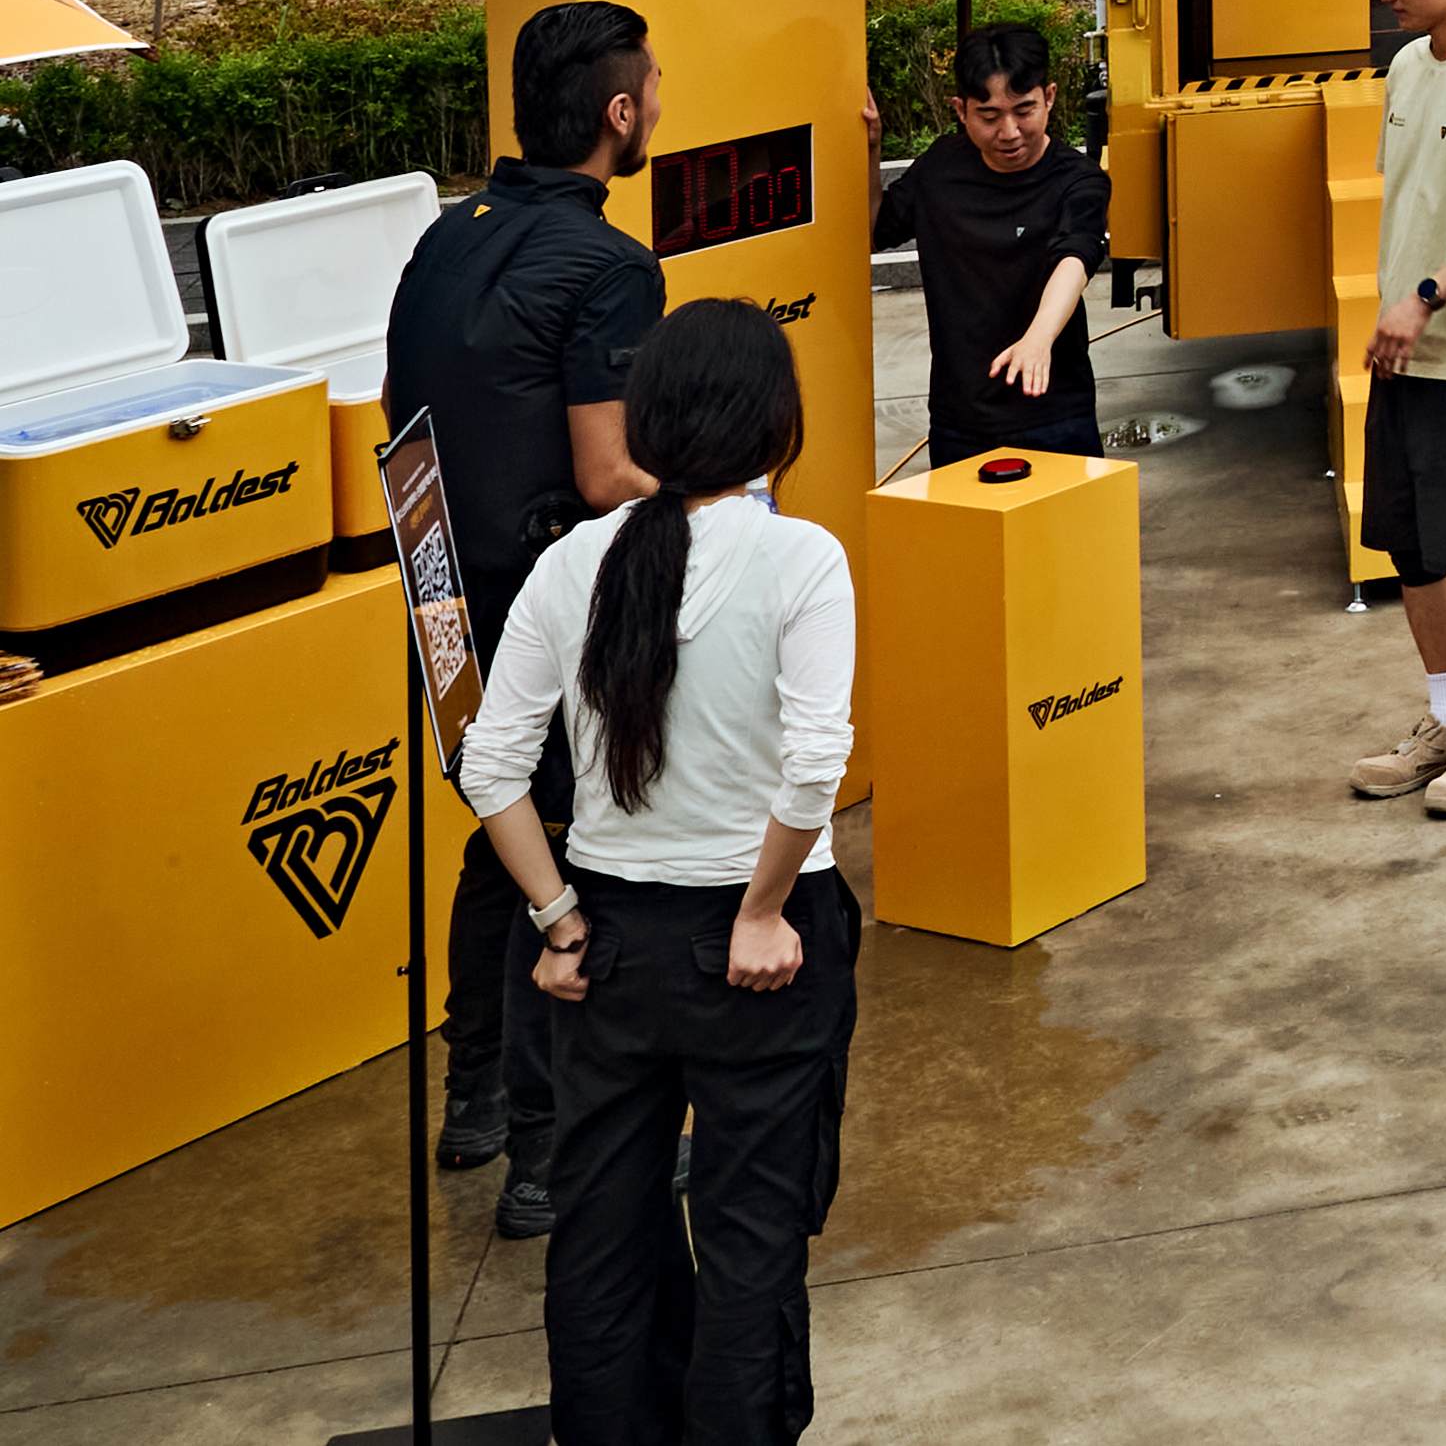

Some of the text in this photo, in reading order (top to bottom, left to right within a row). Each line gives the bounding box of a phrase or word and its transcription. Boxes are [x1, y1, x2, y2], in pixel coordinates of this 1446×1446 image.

[130, 461, 300, 536] Boldest
[1050, 675, 1123, 722] Boldest
[240, 737, 400, 826] Boldest
